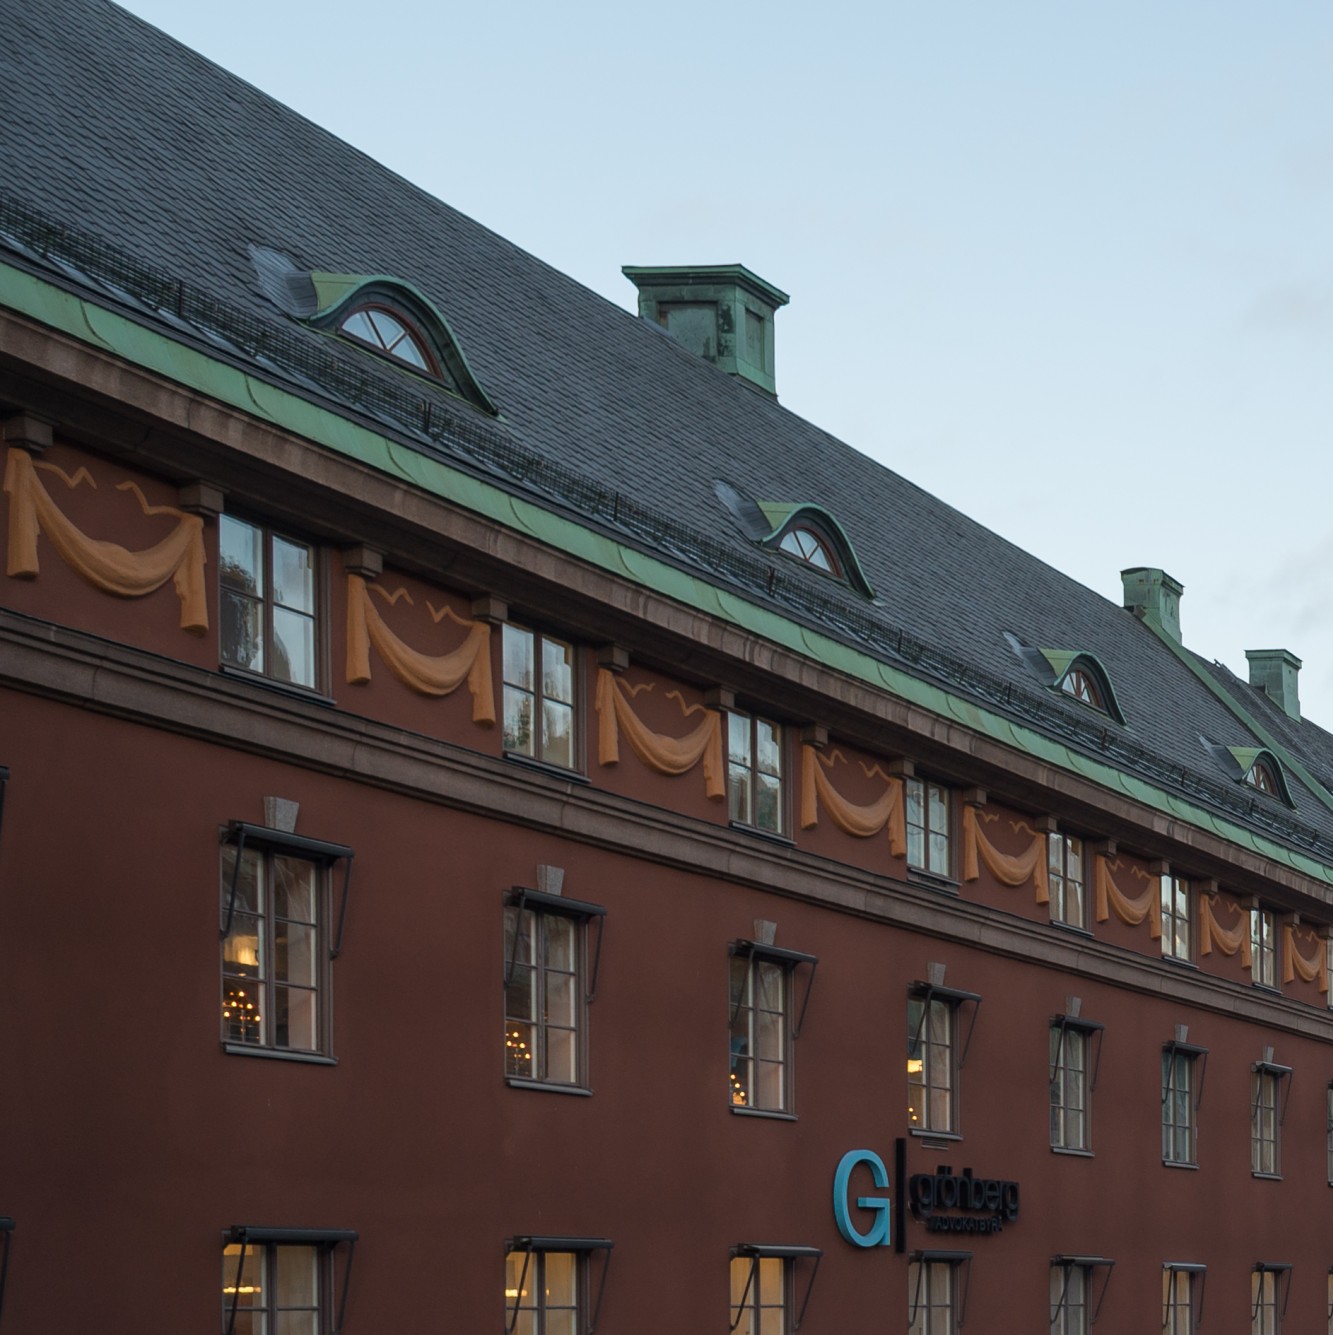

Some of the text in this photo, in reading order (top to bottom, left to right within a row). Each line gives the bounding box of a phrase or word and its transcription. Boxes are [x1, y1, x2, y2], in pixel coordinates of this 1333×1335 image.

[833, 1148, 891, 1247] G
[910, 1165, 1020, 1222] grönberg
[932, 1216, 1003, 1232] ADVOKATBYR
